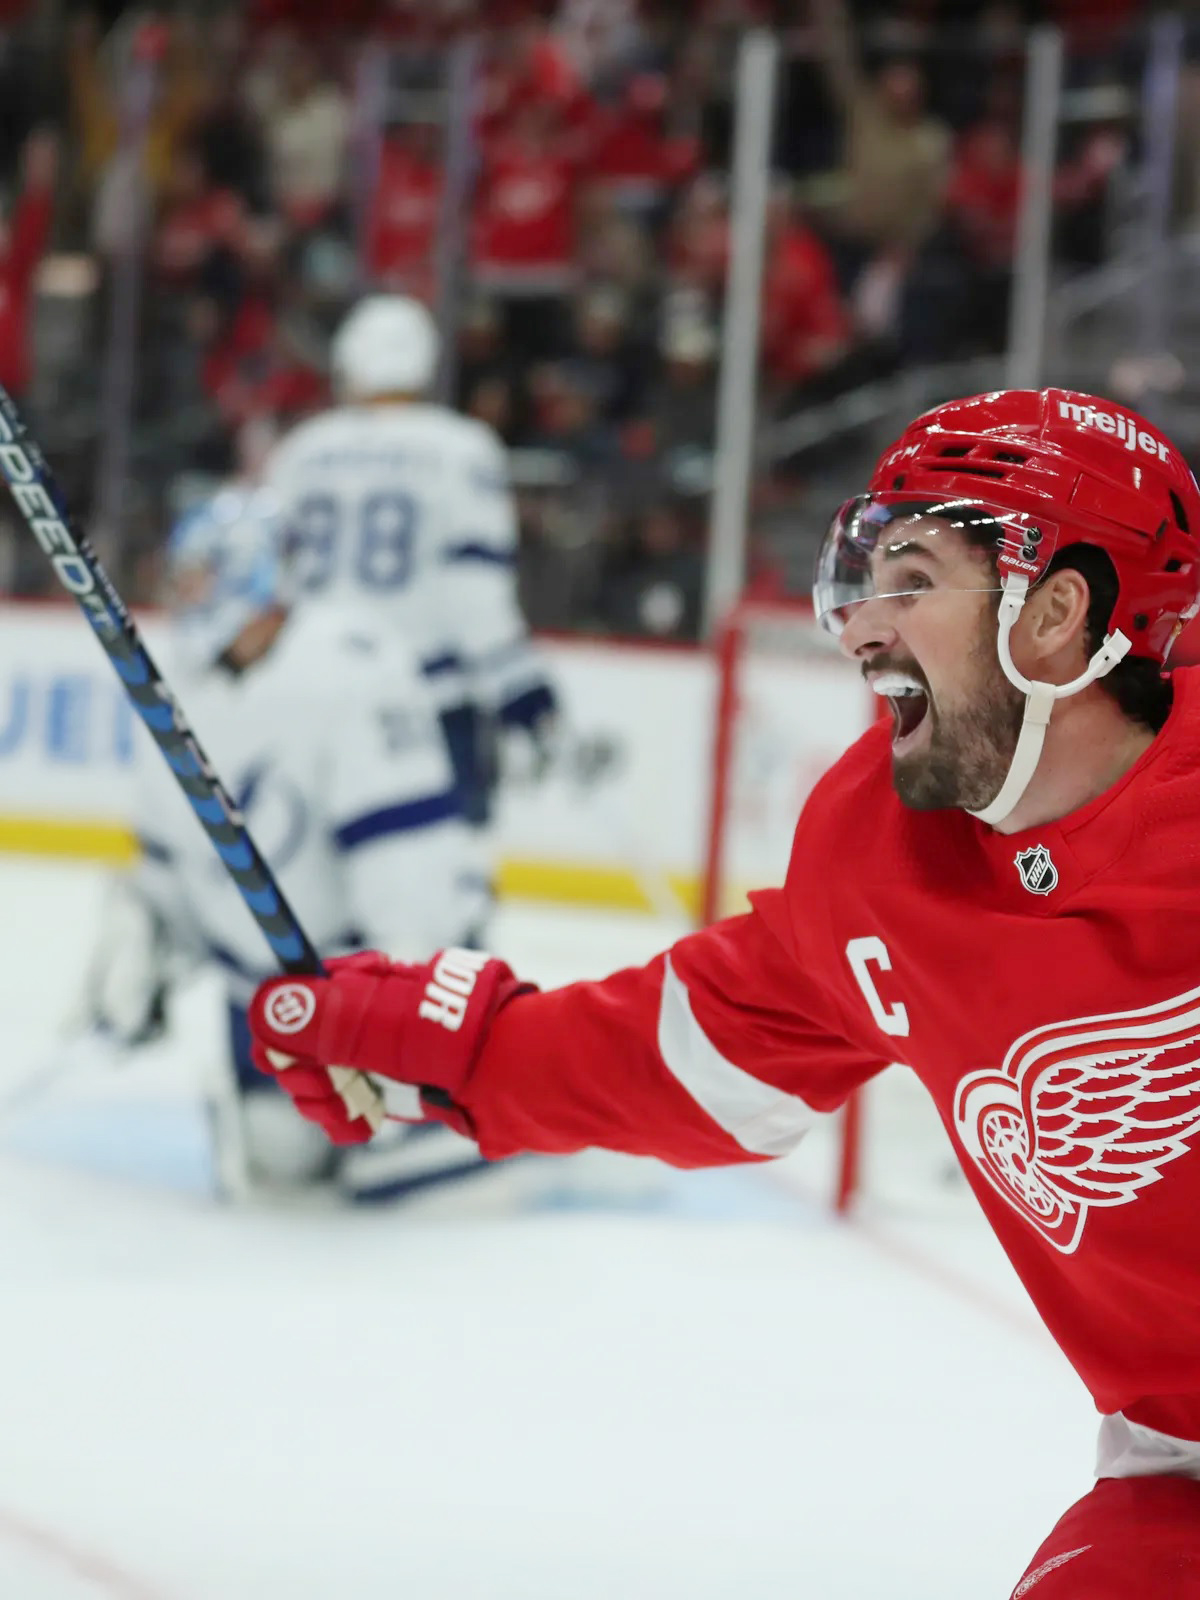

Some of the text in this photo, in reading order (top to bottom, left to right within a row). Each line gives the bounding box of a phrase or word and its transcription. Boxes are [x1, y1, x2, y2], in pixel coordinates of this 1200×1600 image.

[1058, 399, 1170, 463] meijer
[1000, 555, 1038, 573] BAUER
[1029, 858, 1046, 887] NHL
[845, 936, 910, 1037] C
